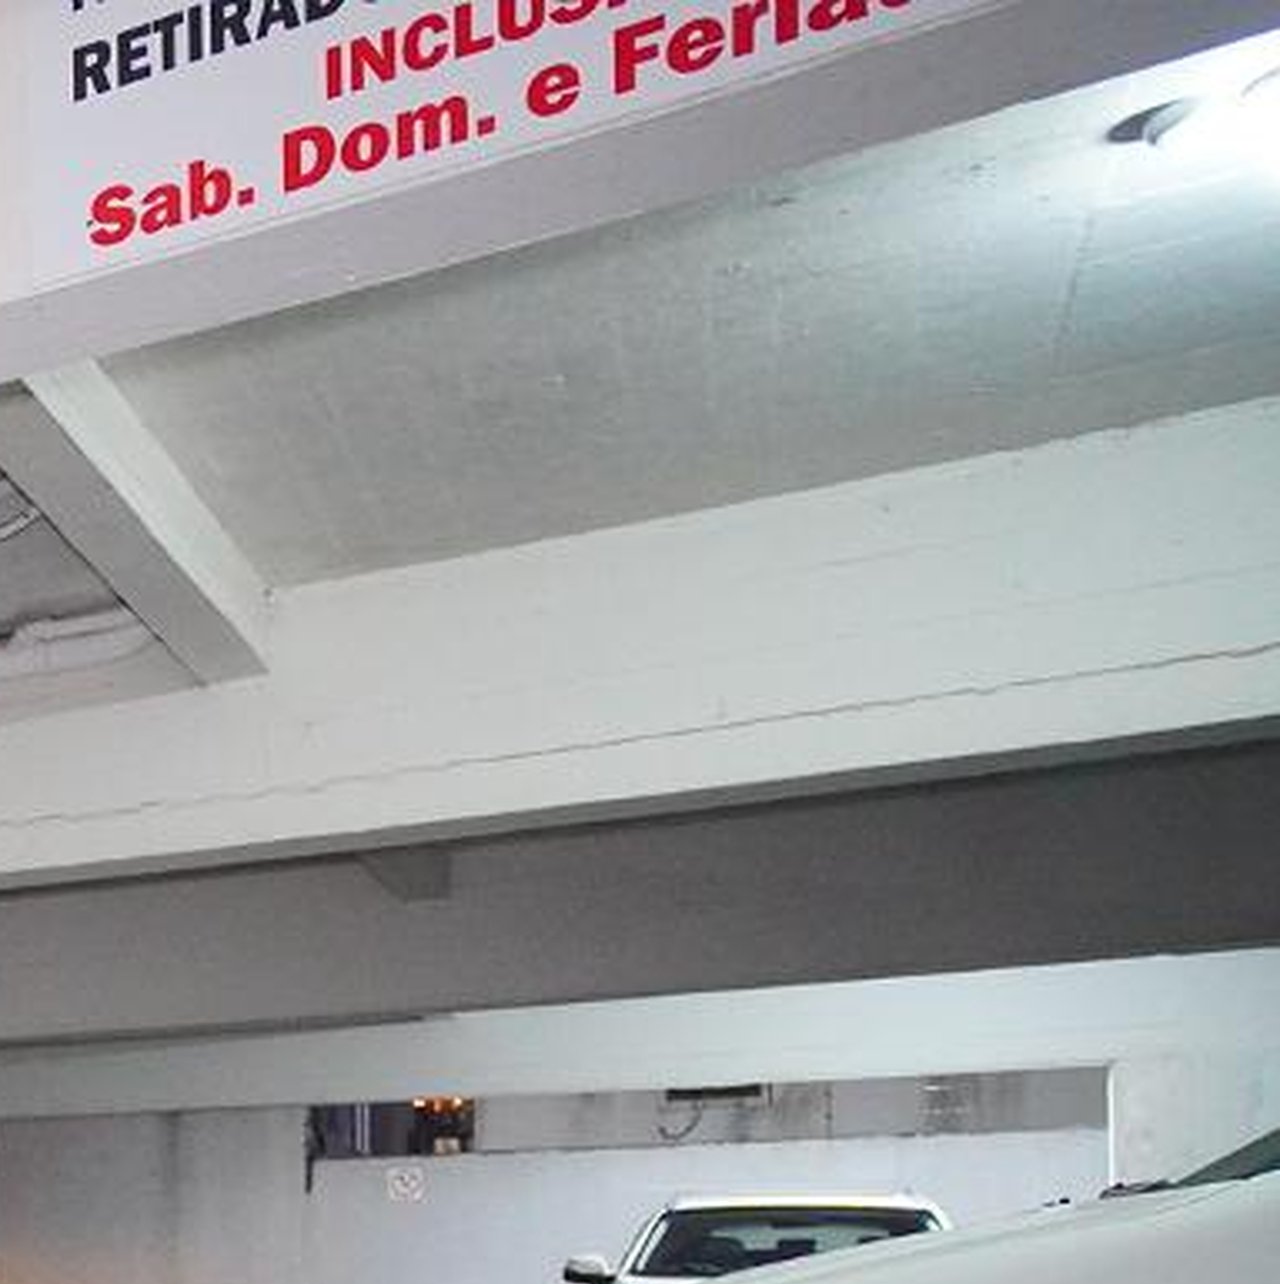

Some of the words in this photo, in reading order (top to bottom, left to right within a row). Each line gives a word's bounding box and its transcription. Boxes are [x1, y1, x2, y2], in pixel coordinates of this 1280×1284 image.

[90, 160, 254, 245] Sab.
[283, 96, 495, 193] Dom.
[526, 63, 580, 117] e
